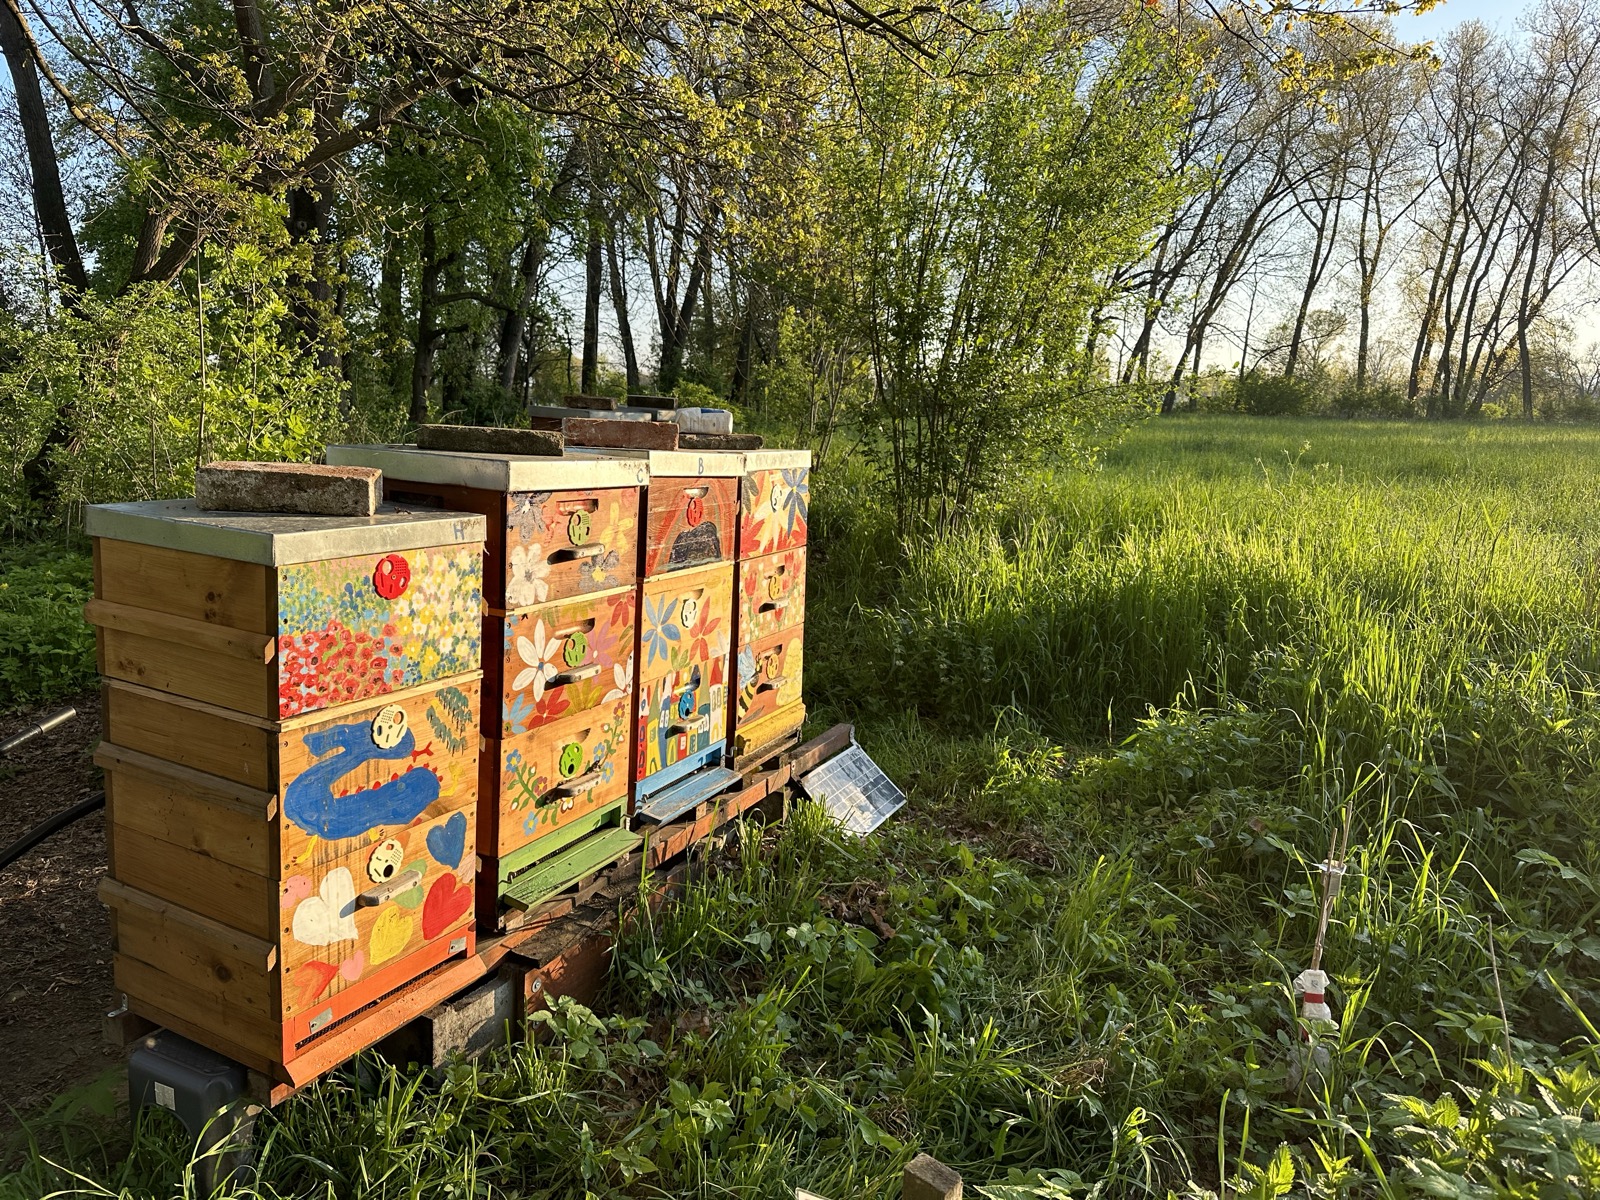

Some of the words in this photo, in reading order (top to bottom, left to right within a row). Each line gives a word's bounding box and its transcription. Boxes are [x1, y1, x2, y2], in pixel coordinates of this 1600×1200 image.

[698, 457, 704, 475] B
[637, 468, 644, 483] C
[453, 520, 465, 540] H
